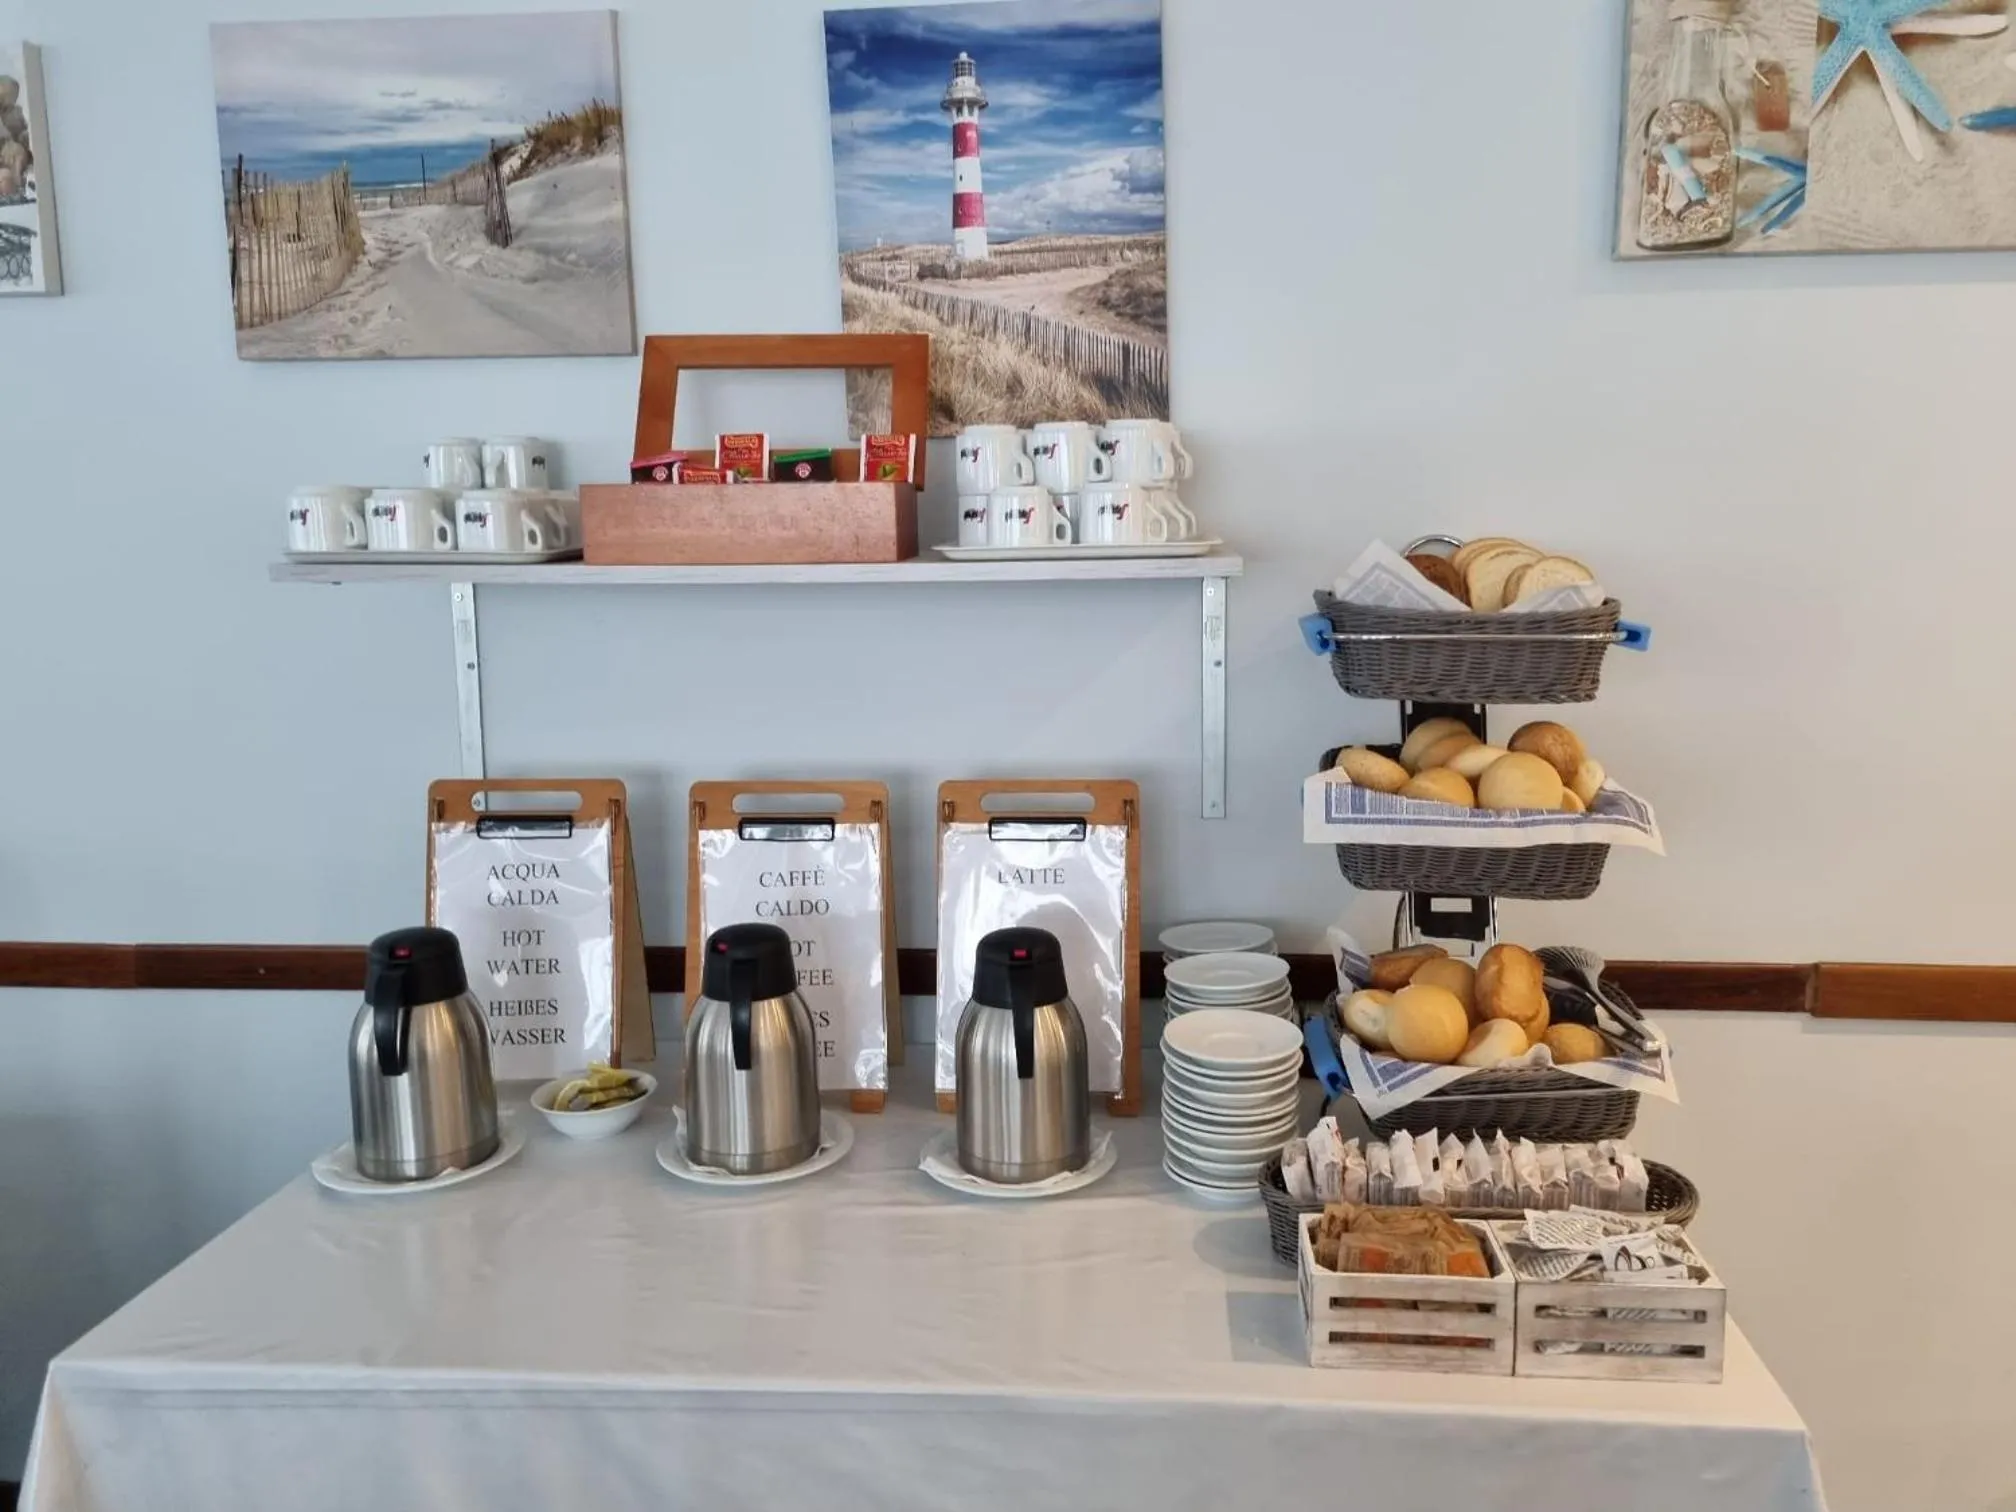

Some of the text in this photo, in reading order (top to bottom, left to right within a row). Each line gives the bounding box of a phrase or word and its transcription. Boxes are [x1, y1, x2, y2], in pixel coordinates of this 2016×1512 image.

[487, 863, 560, 884] ACQUA
[998, 868, 1065, 884] LATTE
[487, 889, 559, 907] CALDA
[755, 899, 830, 917] CALDO
[502, 929, 545, 947] HOT
[790, 940, 816, 958] OT
[487, 958, 561, 976] WATER
